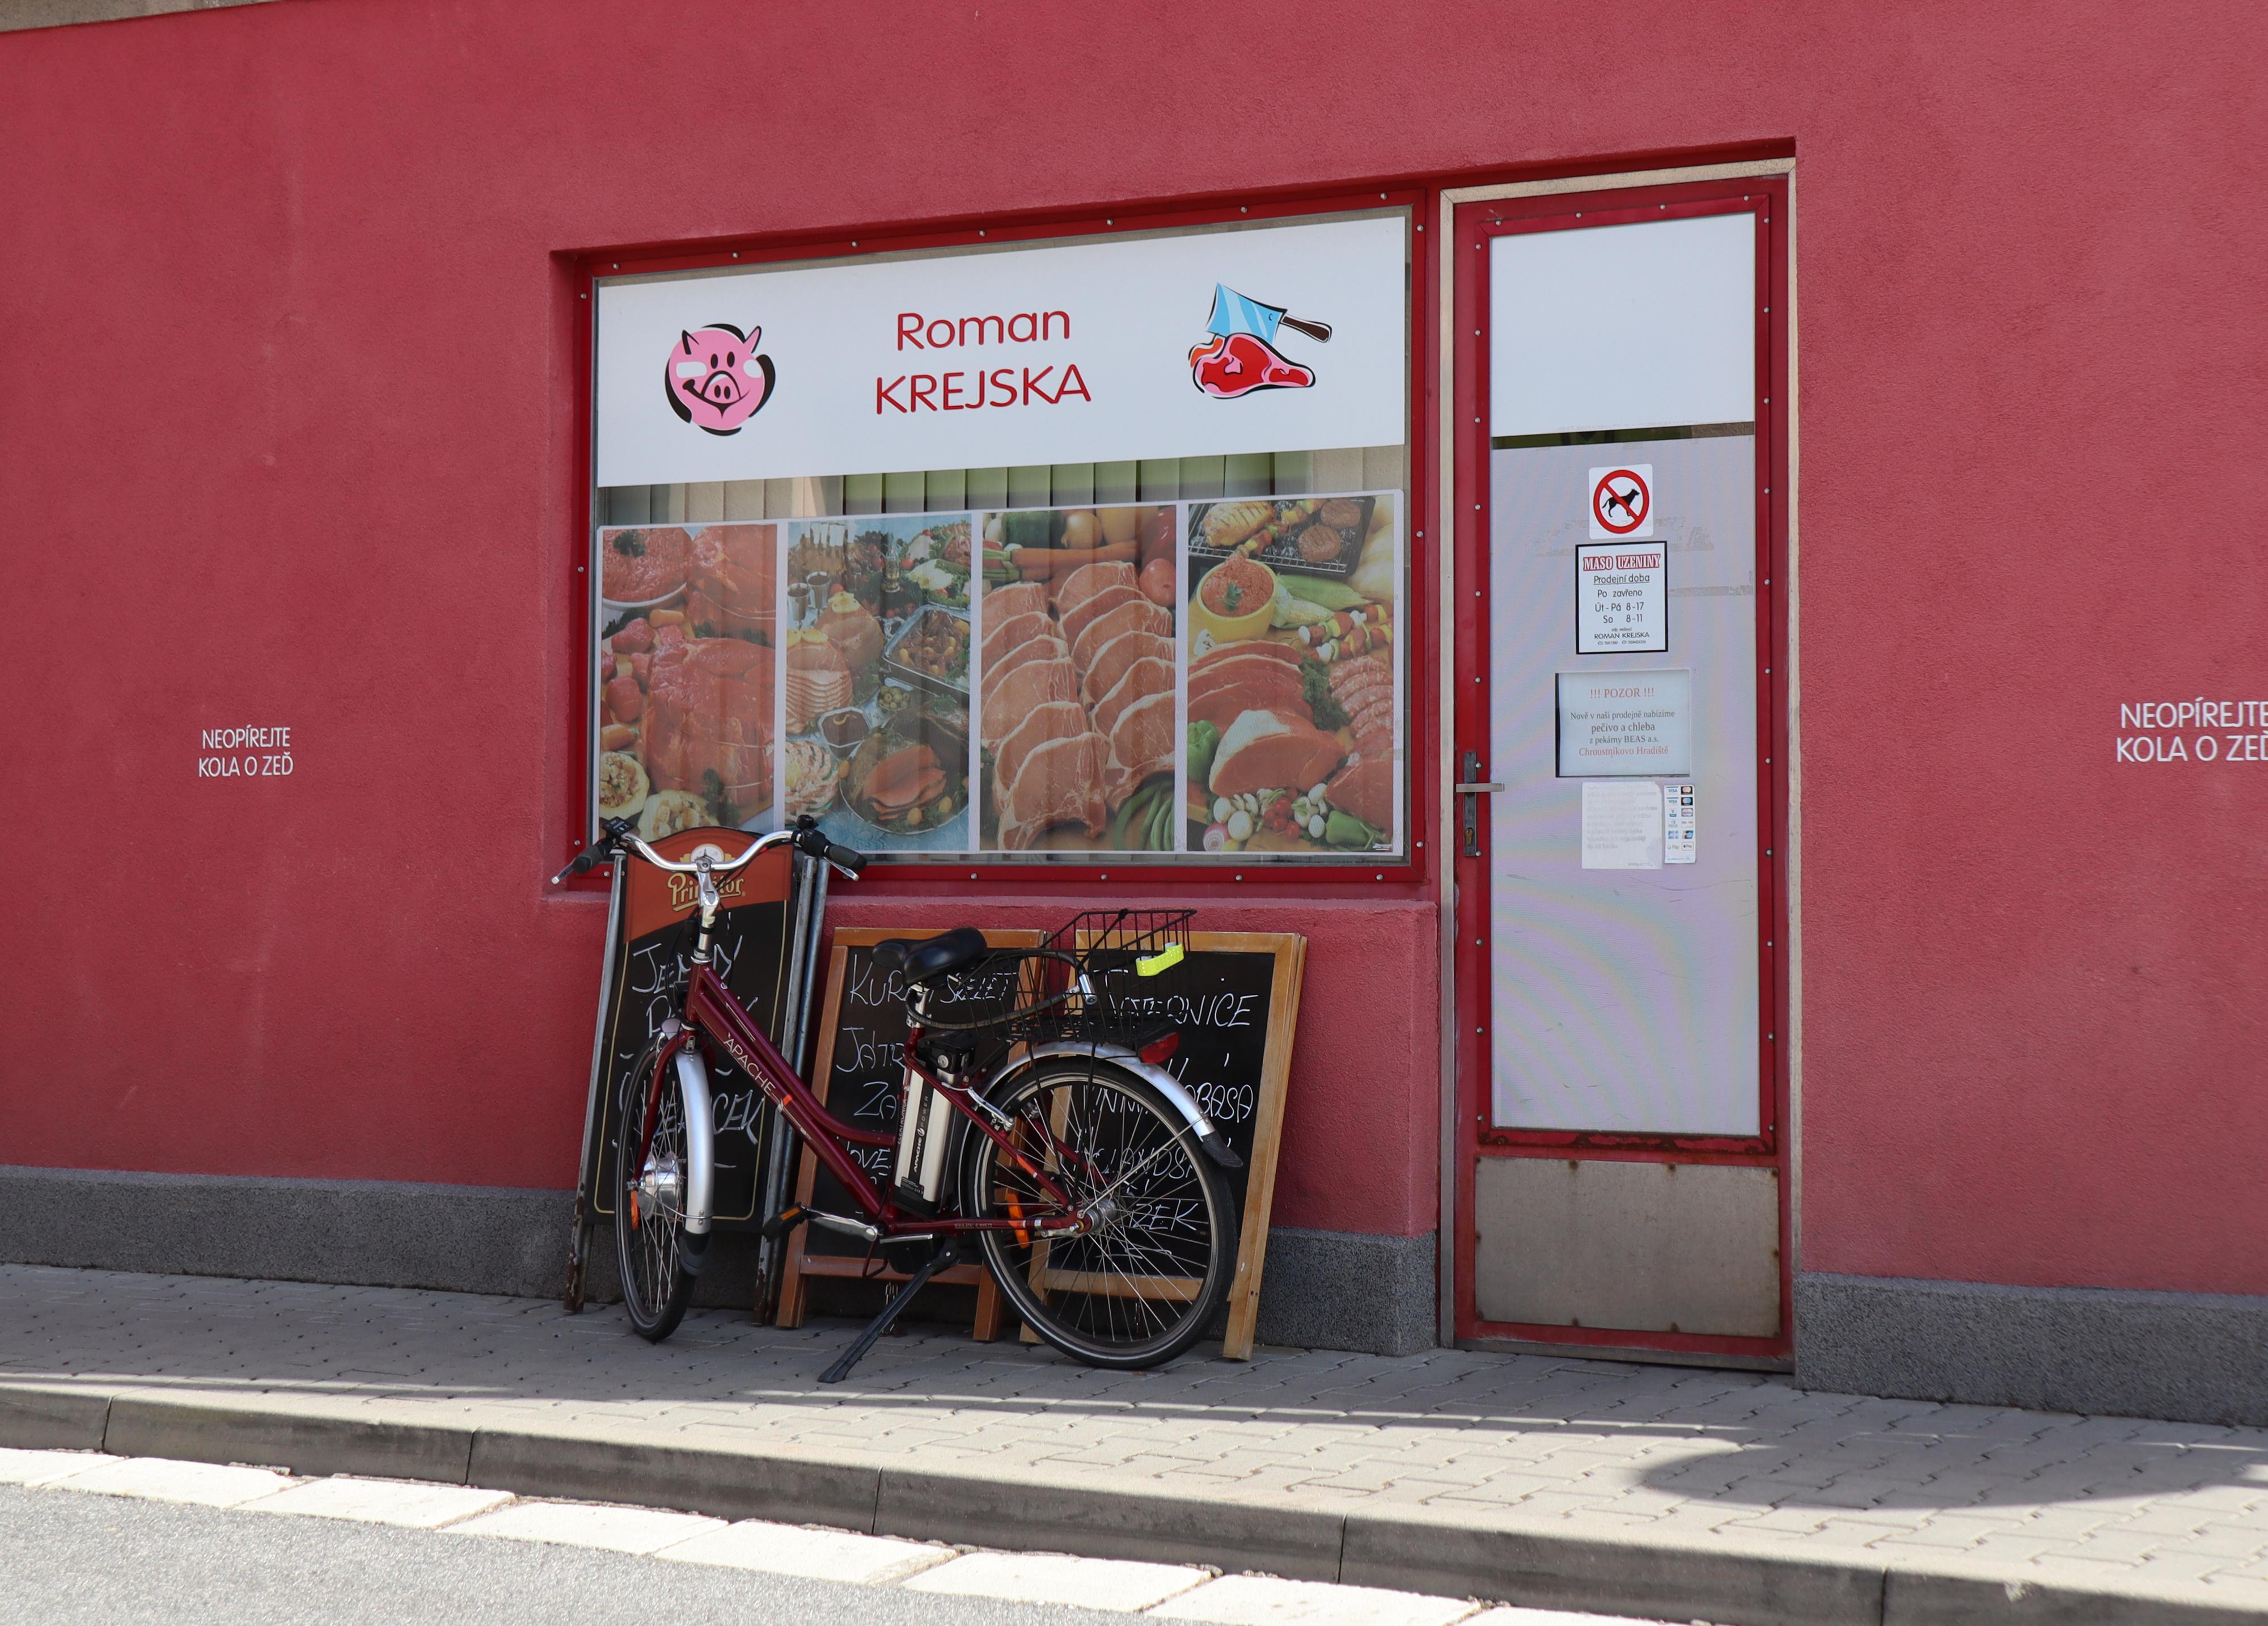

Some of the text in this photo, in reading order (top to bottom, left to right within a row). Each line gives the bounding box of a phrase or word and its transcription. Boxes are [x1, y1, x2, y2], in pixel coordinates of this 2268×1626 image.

[898, 310, 1070, 351] Roman
[877, 364, 1091, 415] KREJSKA
[1583, 554, 1660, 571] MASO UZENINY
[1594, 573, 1649, 585] Prodejní doba
[1597, 589, 1643, 598] Po zavřeno
[1603, 615, 1613, 623] So
[1604, 688, 1640, 698] POZOR
[1612, 710, 1641, 720] prodejně
[1644, 709, 1675, 718] nabízíme
[1591, 723, 1618, 734] pečivo
[1628, 721, 1655, 732] chleba
[202, 724, 290, 749] NEOPÍREJTE
[1636, 746, 1669, 755] Hradiště
[2117, 736, 2188, 762] KOLA
[2195, 736, 2218, 761] O
[199, 751, 293, 777] KOLA O ZEĎ
[723, 1037, 777, 1096] APACHE
[913, 1137, 923, 1173] APACHE
